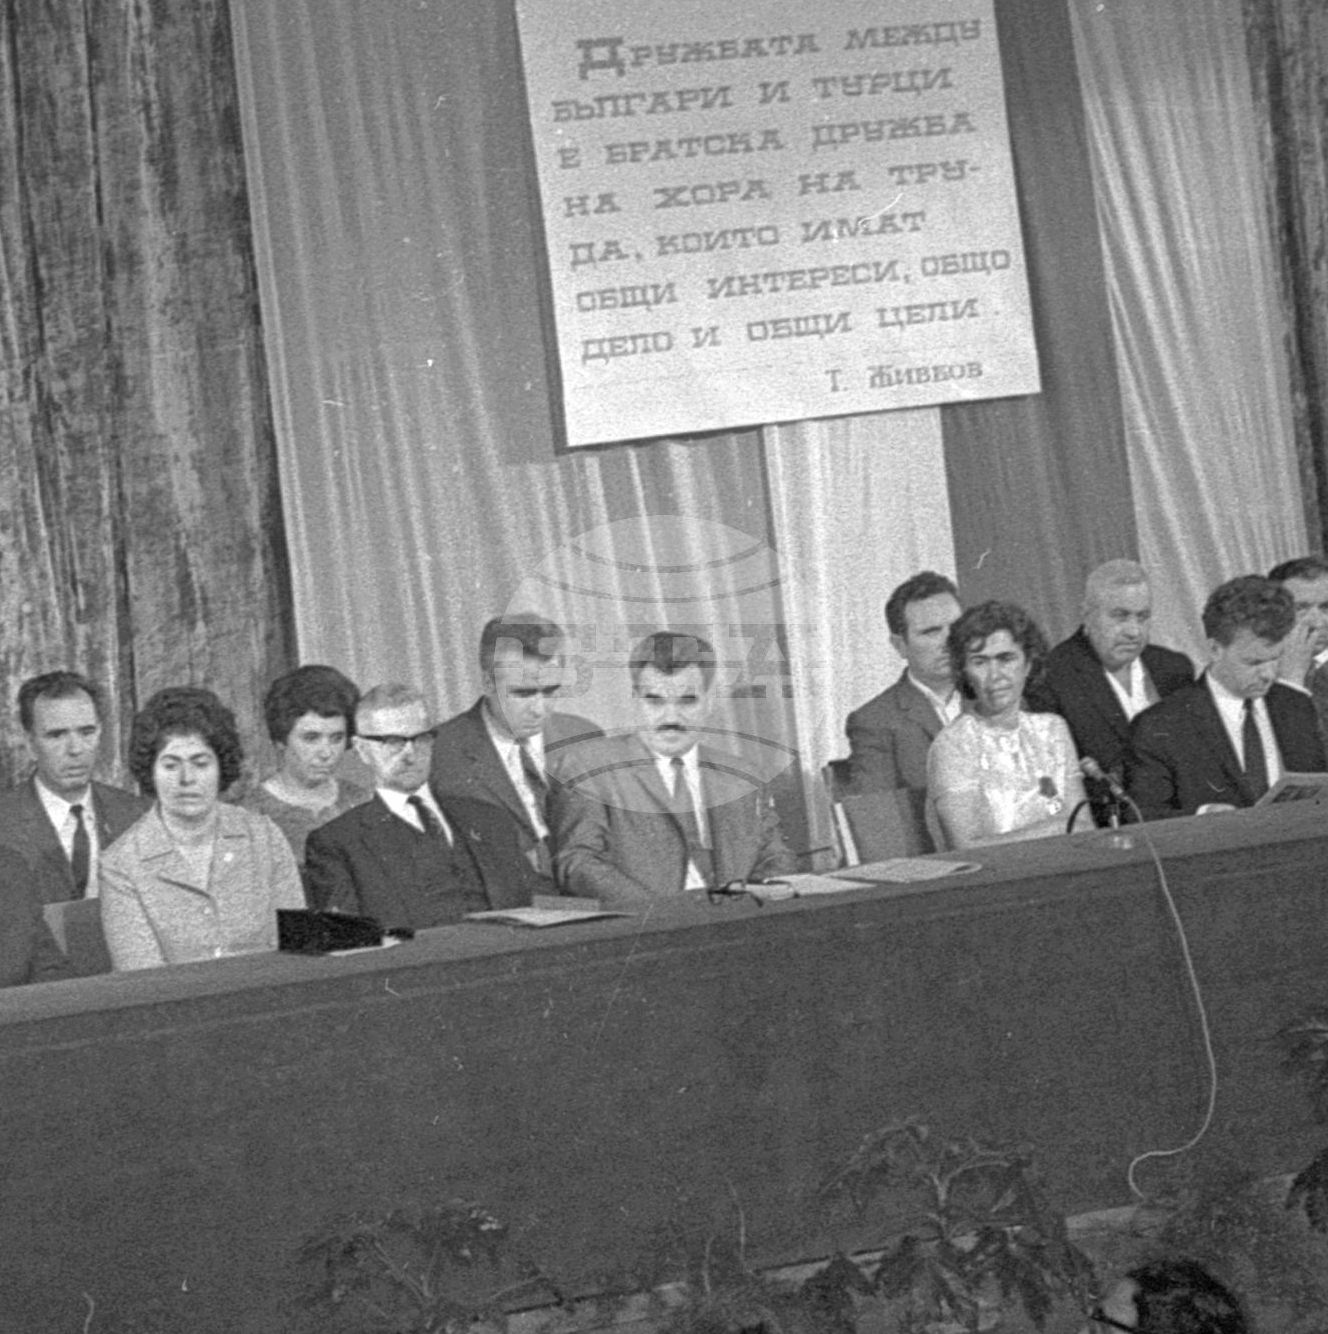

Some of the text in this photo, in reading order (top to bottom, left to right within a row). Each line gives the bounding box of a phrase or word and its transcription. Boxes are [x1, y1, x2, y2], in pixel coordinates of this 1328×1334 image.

[576, 19, 981, 81] ДРУЖБАТА МЕЖДУ
[758, 80, 792, 105] И
[811, 67, 953, 99] ТУРЦИ
[557, 112, 977, 170] Е БРАТСКА ДРУЖБА
[563, 159, 981, 218] НА ХОРА НА ТРУ-
[655, 225, 781, 258] КОИТО
[801, 210, 926, 244] ИМАТ
[576, 249, 1012, 313] ОБЩИ ИНТЕРЕСИ, ОБЩО
[690, 325, 723, 350] И
[746, 311, 853, 343] ОБЩИ
[824, 368, 850, 393] Т.
